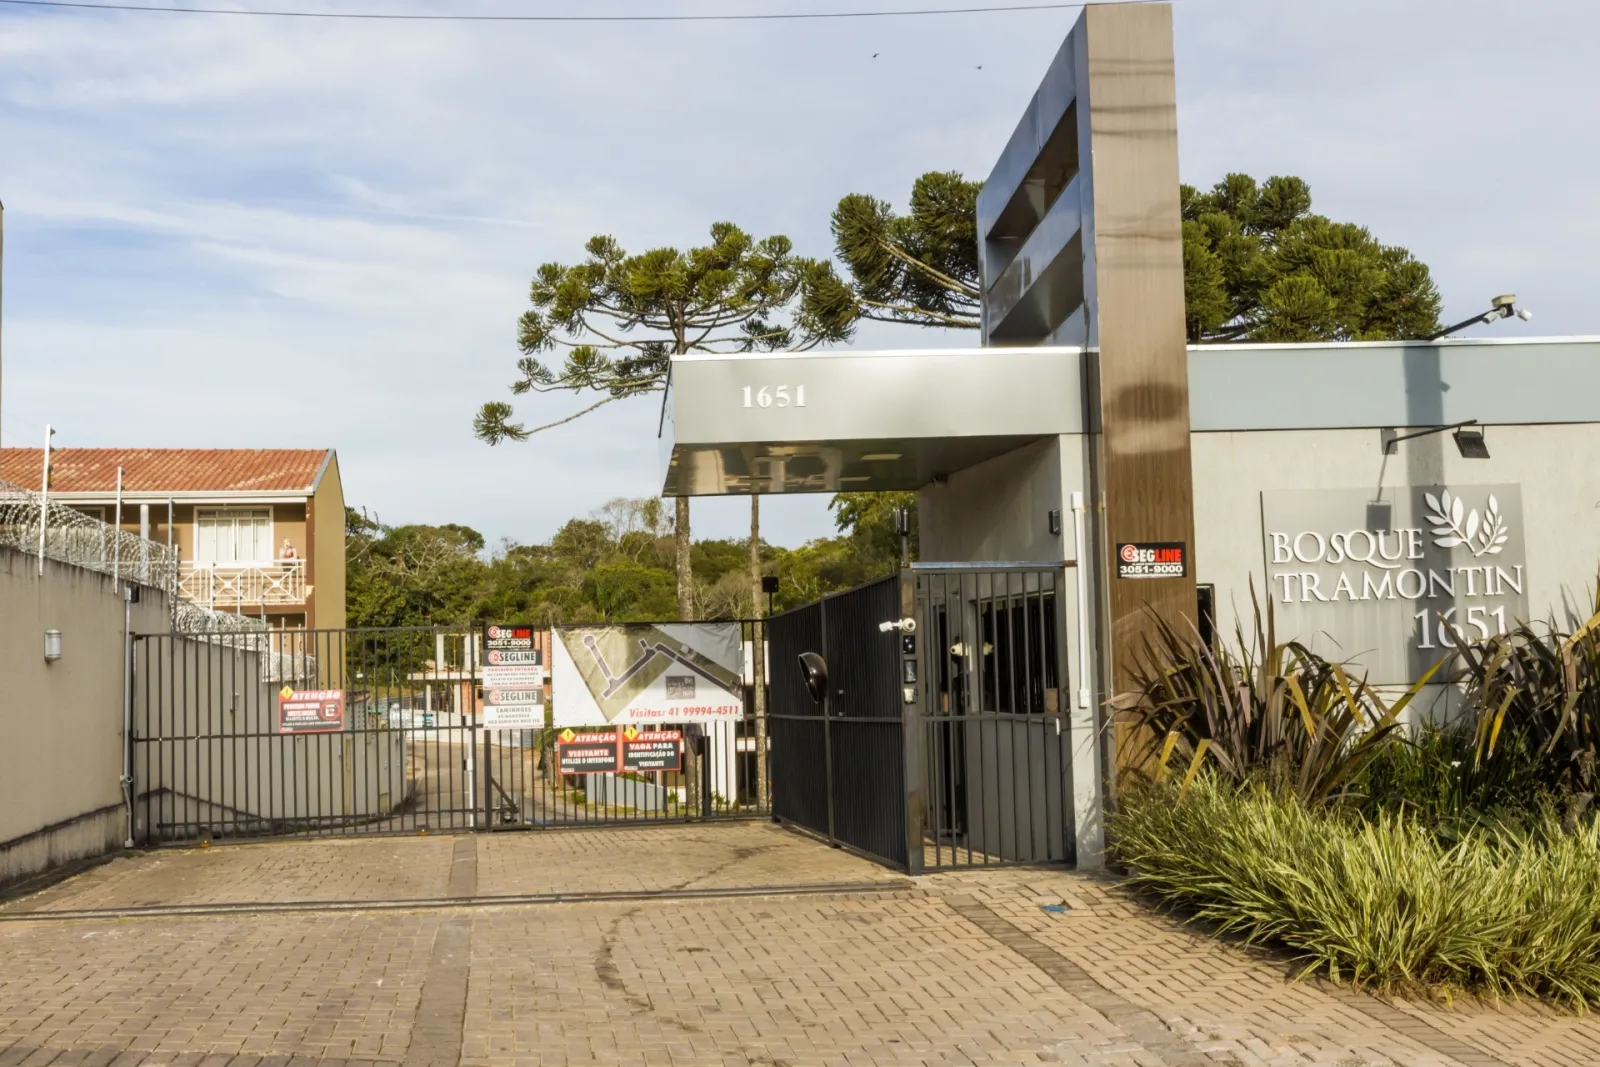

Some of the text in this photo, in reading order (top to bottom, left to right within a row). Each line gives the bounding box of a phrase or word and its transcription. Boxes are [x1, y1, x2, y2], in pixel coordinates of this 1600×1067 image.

[740, 384, 807, 409] 1651
[1270, 528, 1425, 569] BOSQUE
[1131, 549, 1181, 562] SEGLINE
[1120, 565, 1183, 573] 3051-9000
[1273, 565, 1524, 604] TRAMONTIN
[1413, 605, 1505, 649] 1651
[495, 629, 530, 638] SEGLINE
[500, 651, 535, 661] SEGLINE
[500, 691, 536, 701] SEGLINE
[629, 705, 739, 718] Visitas: 41 99994-4511
[574, 733, 617, 744] ATENÇÃO
[638, 731, 680, 741] ATENÇÃO
[629, 742, 674, 751] VAGA PARA
[567, 749, 609, 758] VISITANTE
